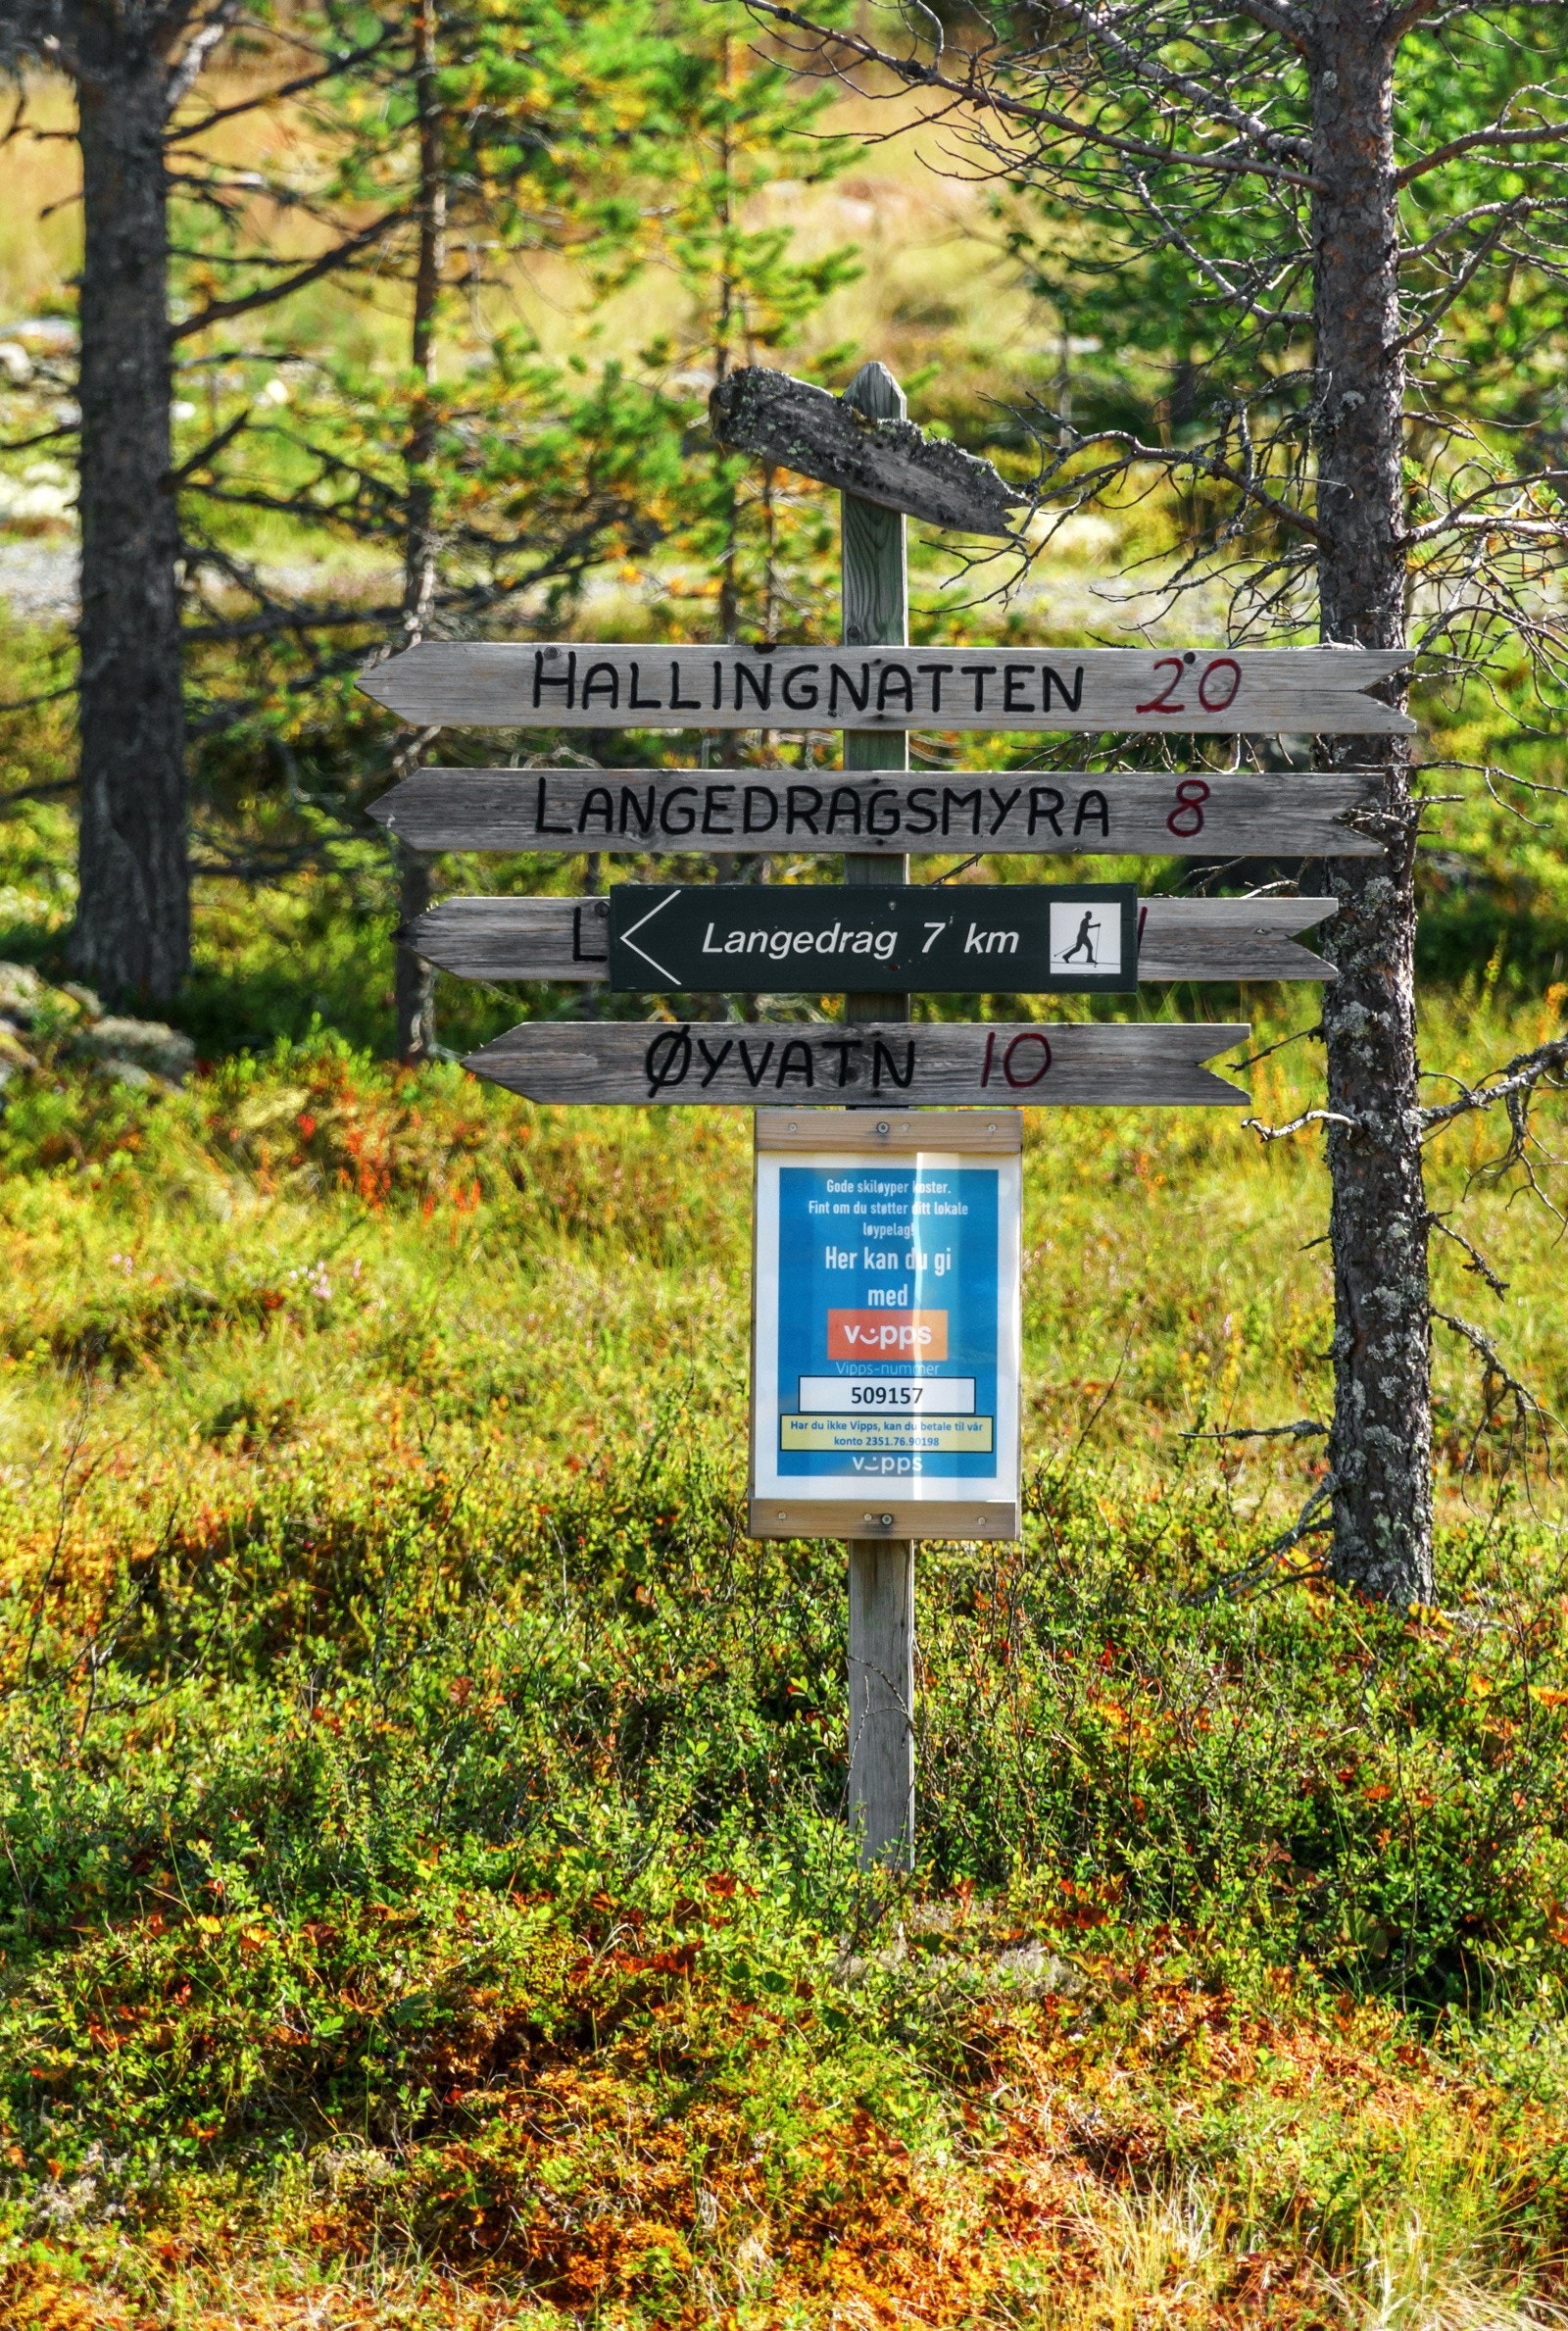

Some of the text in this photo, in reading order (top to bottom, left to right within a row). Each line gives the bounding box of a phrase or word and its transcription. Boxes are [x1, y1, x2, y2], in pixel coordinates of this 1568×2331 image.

[533, 651, 1242, 714] HALLINGNATTEN 20
[535, 777, 1210, 837] LANGEDRAGSMYRA 8
[702, 922, 1019, 959] Langedrag 7 km
[645, 1024, 1052, 1098] ØYVATN 10
[826, 1180, 951, 1196] Gode skiløyper koster.
[808, 1201, 968, 1215] Fint om du støtter ditt lokale
[863, 1223, 913, 1239] løypelag!
[826, 1247, 951, 1275] Her kan du gi
[868, 1285, 907, 1307] med
[836, 1363, 940, 1376] Vipps-nummer
[852, 1388, 923, 1404] 509157
[790, 1421, 982, 1432] Har du ikke Vipps, kan du betale til vår
[834, 1437, 939, 1446] konto 2351.76.90198
